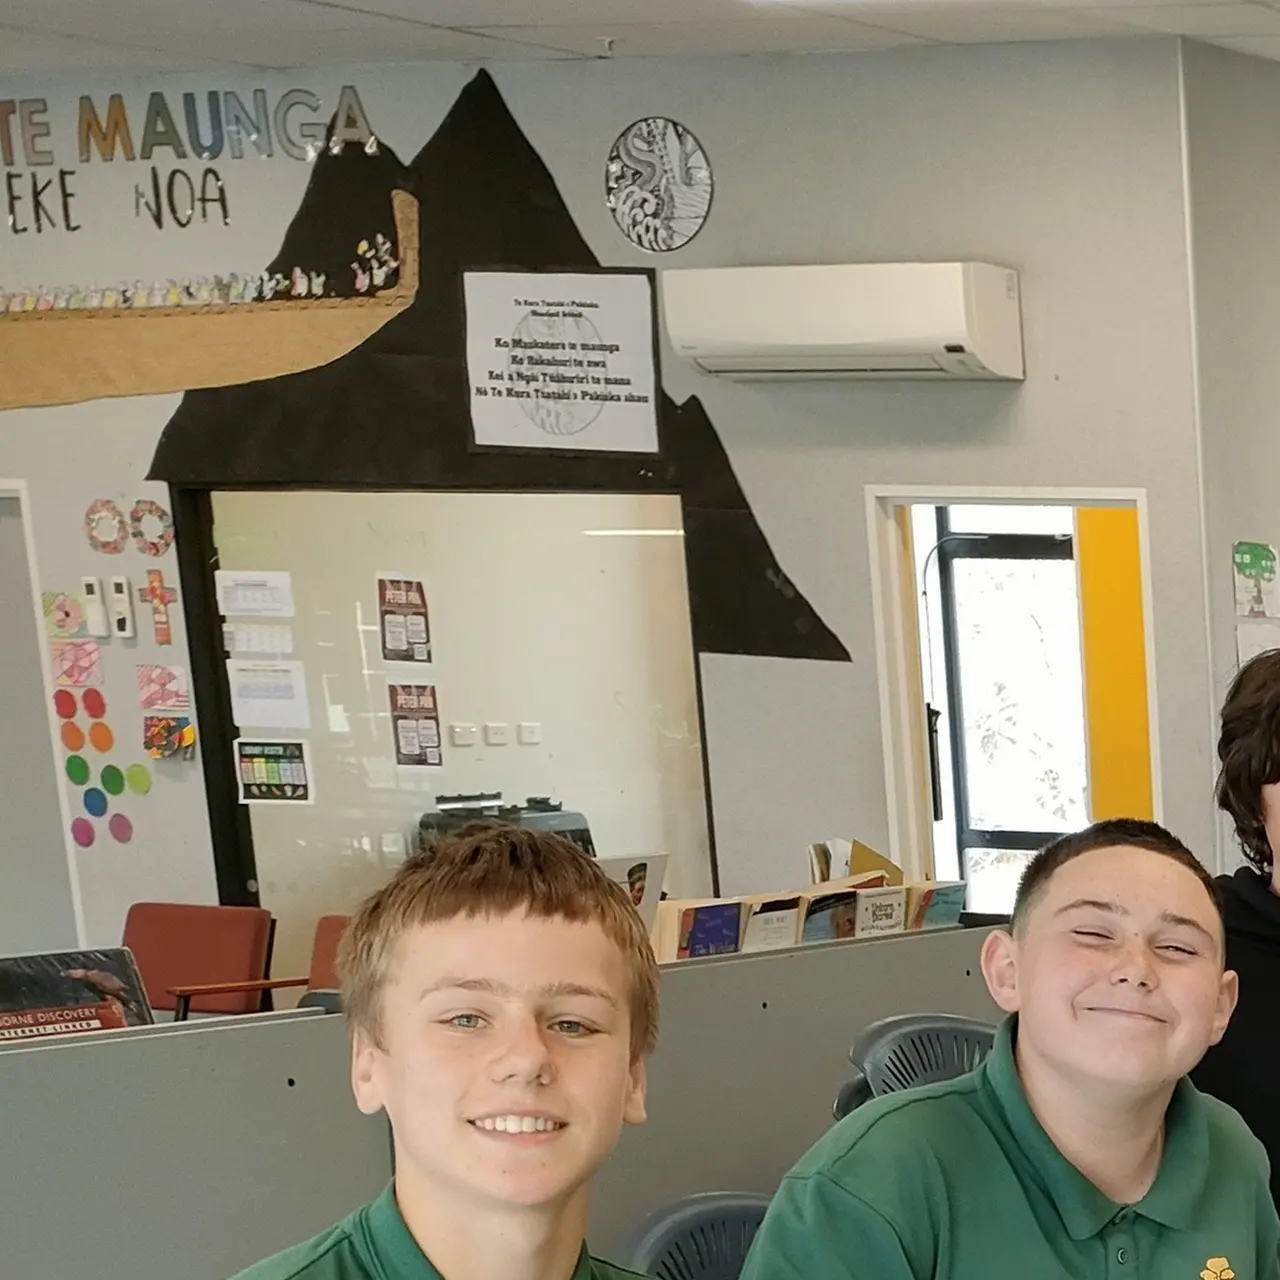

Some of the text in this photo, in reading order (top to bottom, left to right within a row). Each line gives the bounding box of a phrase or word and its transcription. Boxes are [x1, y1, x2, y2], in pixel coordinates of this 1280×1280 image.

[78, 85, 377, 162] MAUNGA
[6, 166, 232, 234] EKE NOA
[494, 337, 510, 349] Ko
[510, 355, 524, 366] Ko
[490, 387, 503, 398] Te
[505, 387, 532, 399] Kura
[37, 1007, 97, 1023] DISCOVERY
